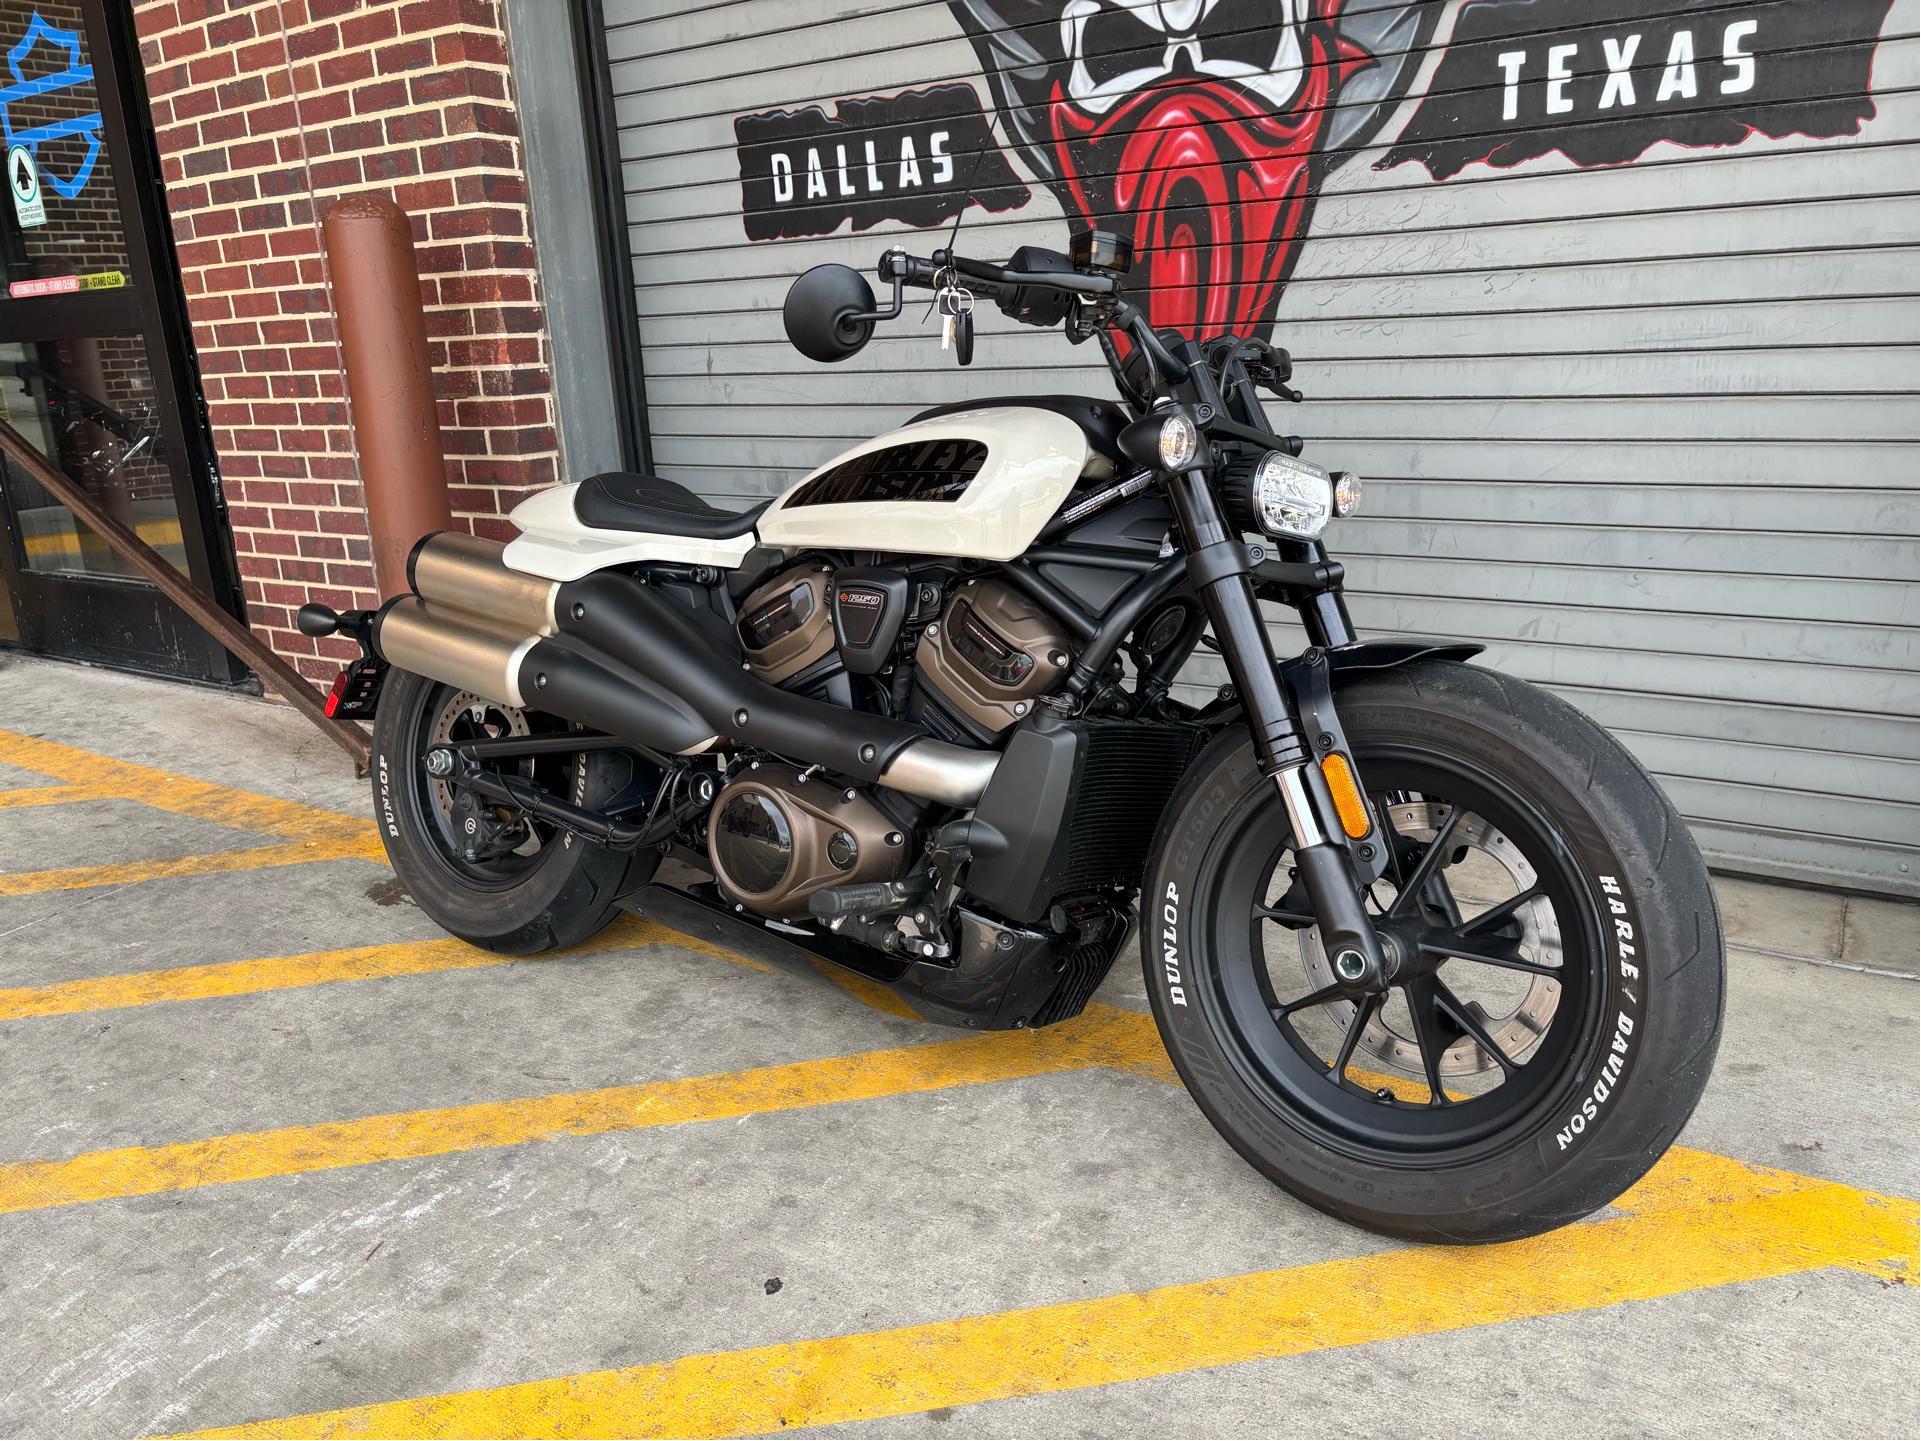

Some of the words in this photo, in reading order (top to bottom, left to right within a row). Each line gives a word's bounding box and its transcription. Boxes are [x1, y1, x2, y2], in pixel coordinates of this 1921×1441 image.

[1498, 19, 1757, 120] TEXAS
[771, 131, 953, 203] DALLAS
[13, 283, 35, 296] AUTOMATIC
[35, 281, 47, 294] DOOR
[49, 280, 62, 292] STAND
[62, 278, 76, 290] CLEAR
[92, 276, 106, 287] STAND
[106, 274, 121, 286] CLEAR
[847, 593, 880, 605] 1250
[379, 754, 400, 838] DUNLOP
[1174, 784, 1226, 873] GT503
[1163, 881, 1188, 1007] DUNLOP
[1555, 1010, 1635, 1151] DAVIDSON
